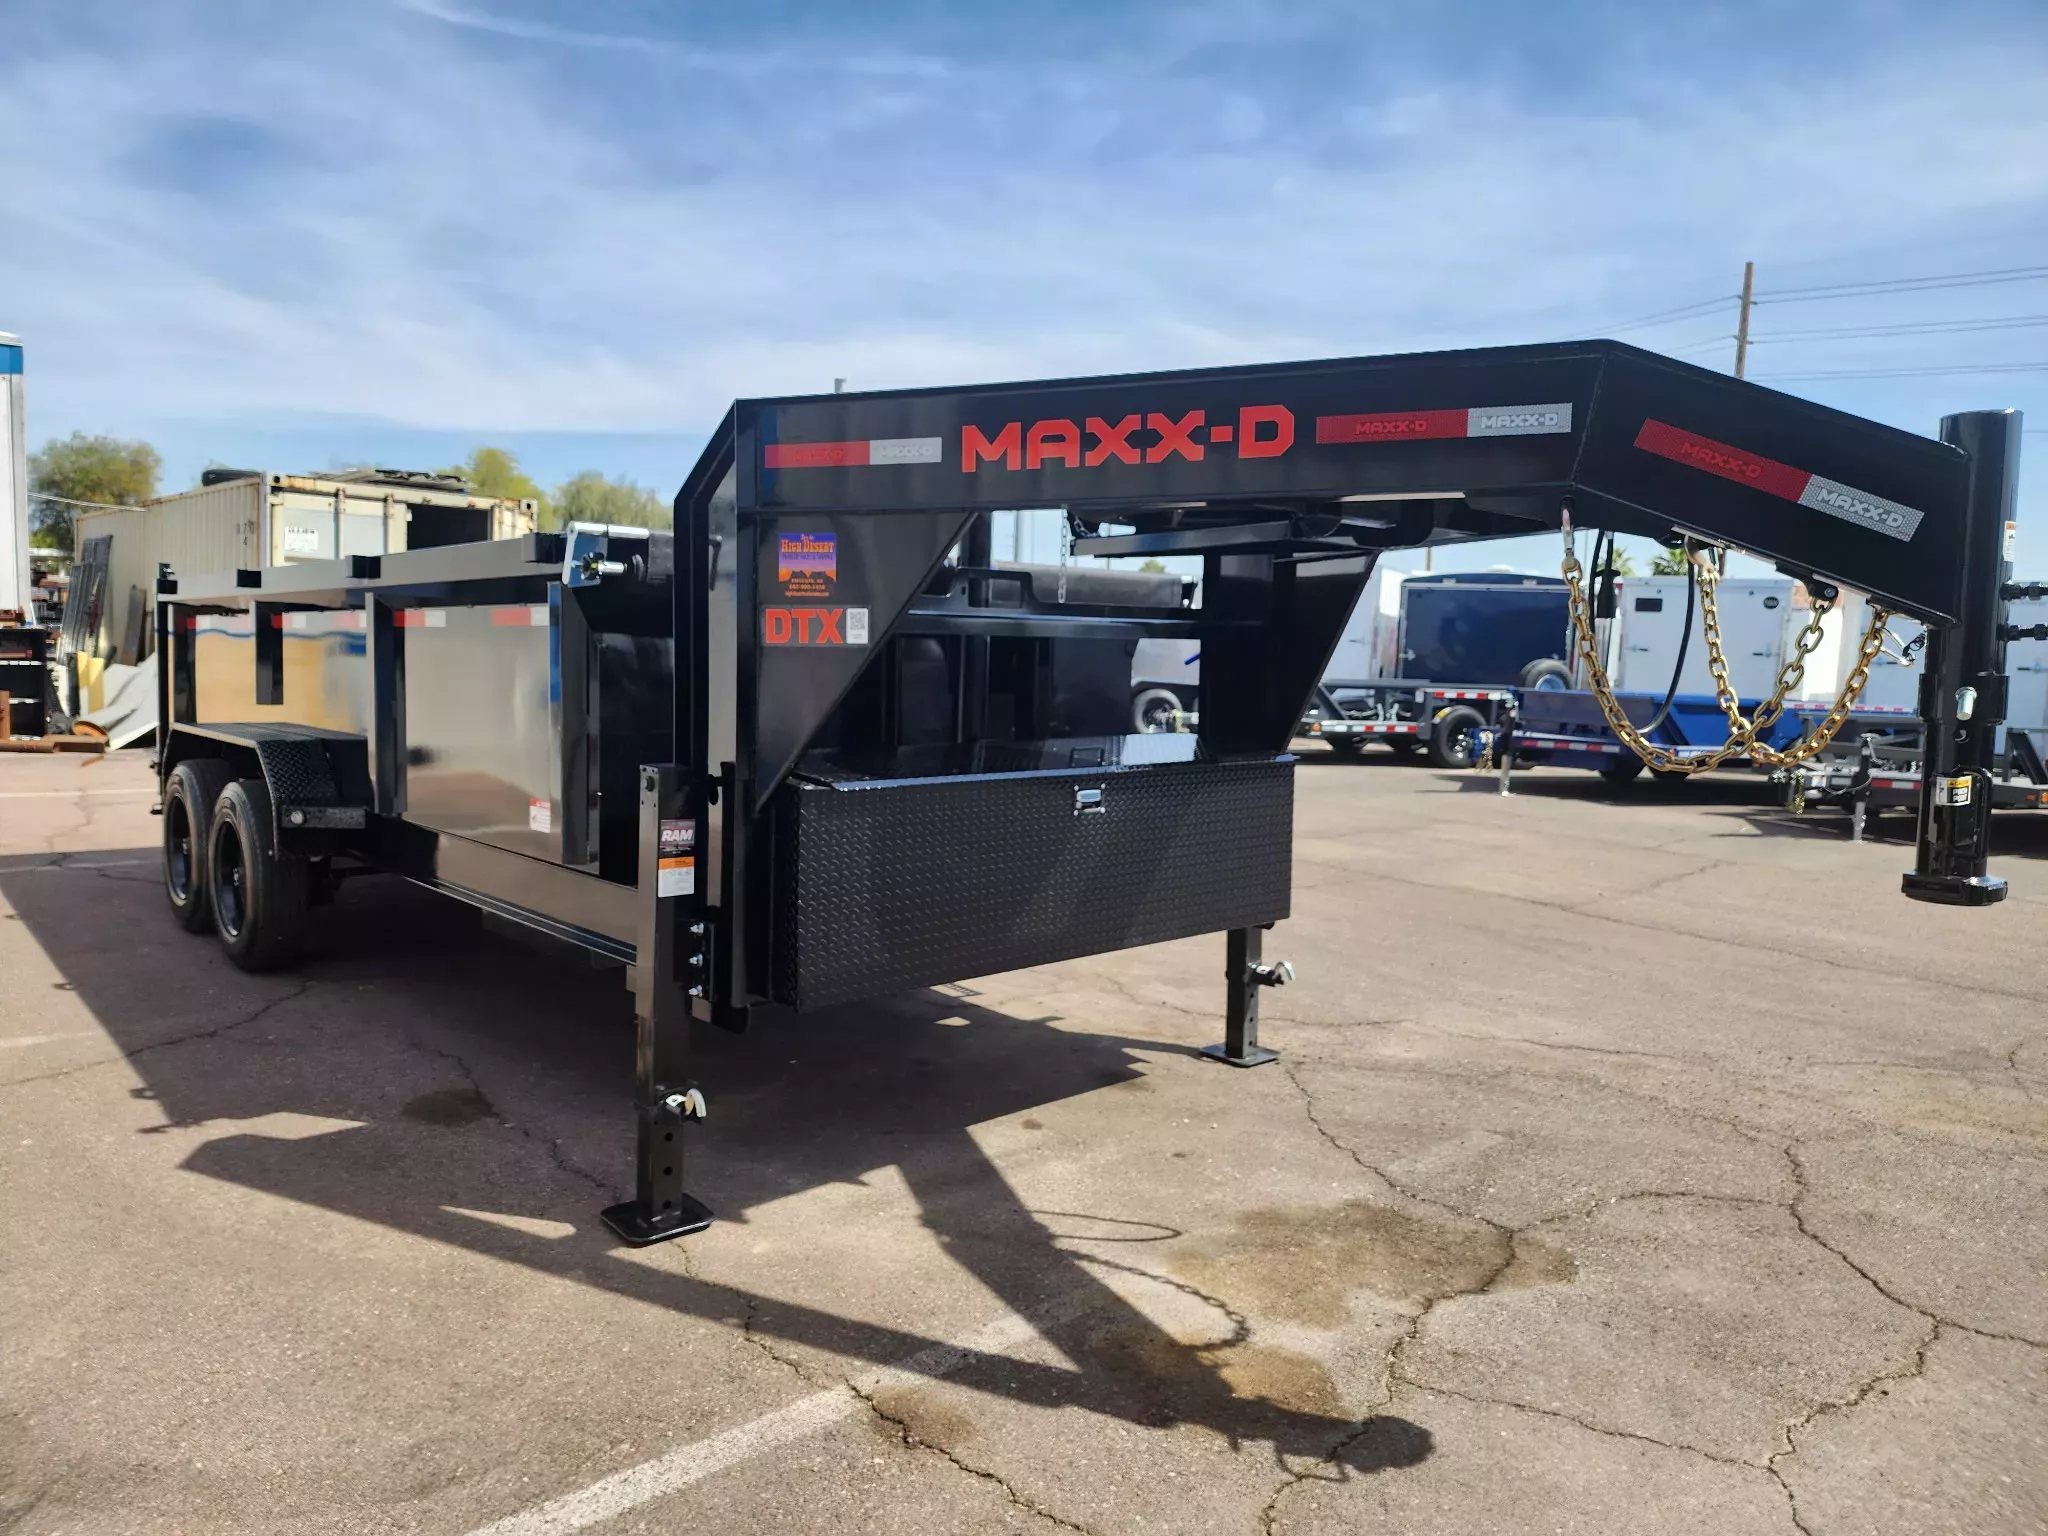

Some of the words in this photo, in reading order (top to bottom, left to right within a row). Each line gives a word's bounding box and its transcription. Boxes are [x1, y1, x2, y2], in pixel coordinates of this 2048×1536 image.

[1355, 419, 1428, 435] MAXX-D
[1481, 412, 1558, 430] MAXX-D
[962, 404, 1294, 473] MAXX-D
[1681, 441, 1762, 479] MAXX-D
[1816, 486, 1906, 529] MAXX-D
[804, 540, 834, 552] DESERT
[766, 608, 843, 644] DTX
[661, 829, 694, 842] RAM
